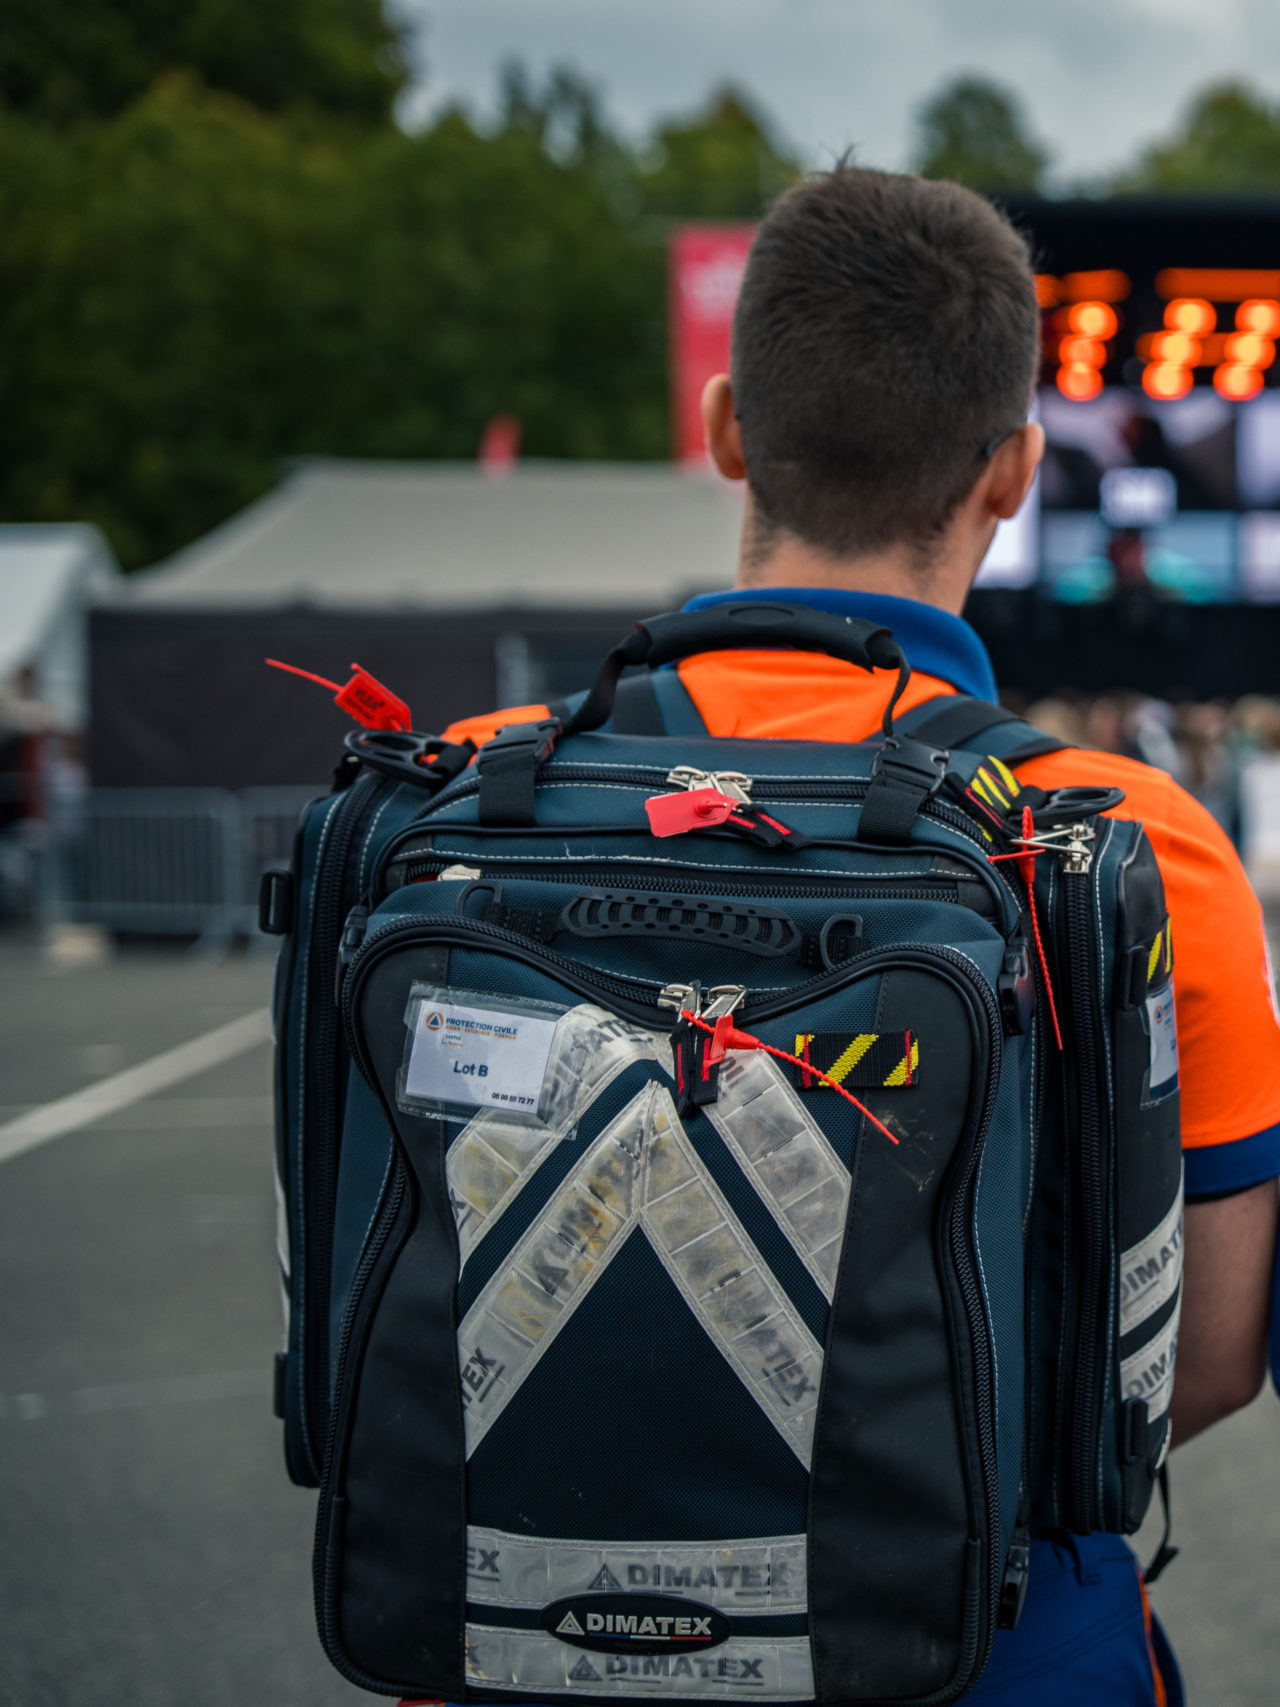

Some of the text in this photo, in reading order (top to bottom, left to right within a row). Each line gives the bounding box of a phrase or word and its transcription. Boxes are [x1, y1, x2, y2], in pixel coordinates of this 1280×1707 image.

[445, 1017, 518, 1036] PROTECTION CIVILE
[453, 1060, 489, 1077] Lot B
[627, 1563, 790, 1588] DIMATEX
[586, 1612, 712, 1635] DIMATEX
[606, 1655, 764, 1679] DIMATEX
